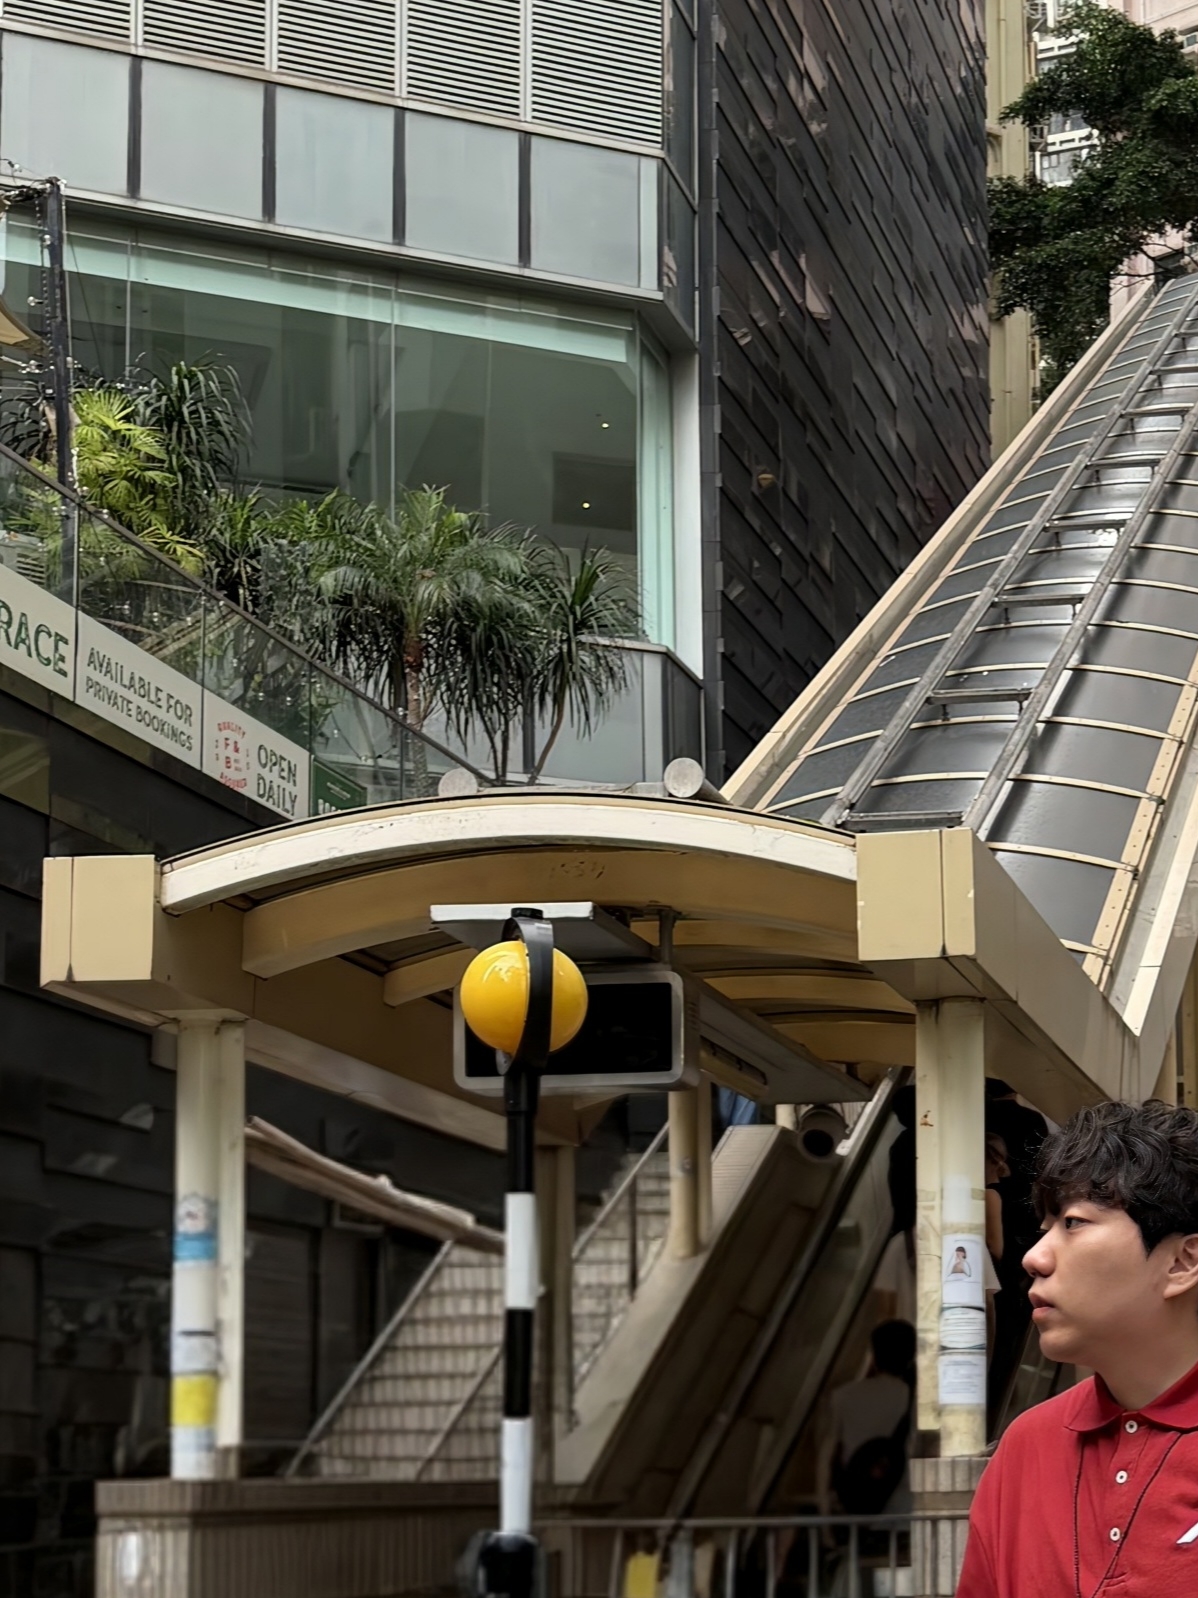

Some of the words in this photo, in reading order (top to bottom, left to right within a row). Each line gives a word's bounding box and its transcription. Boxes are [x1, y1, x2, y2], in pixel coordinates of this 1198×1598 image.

[85, 675, 133, 719] PRIVATE
[135, 703, 193, 752] BOOKINGS
[86, 647, 163, 710] AVAILABLE
[164, 691, 193, 728] FOR
[257, 744, 297, 787] OPEN
[257, 773, 297, 817] DAILY
